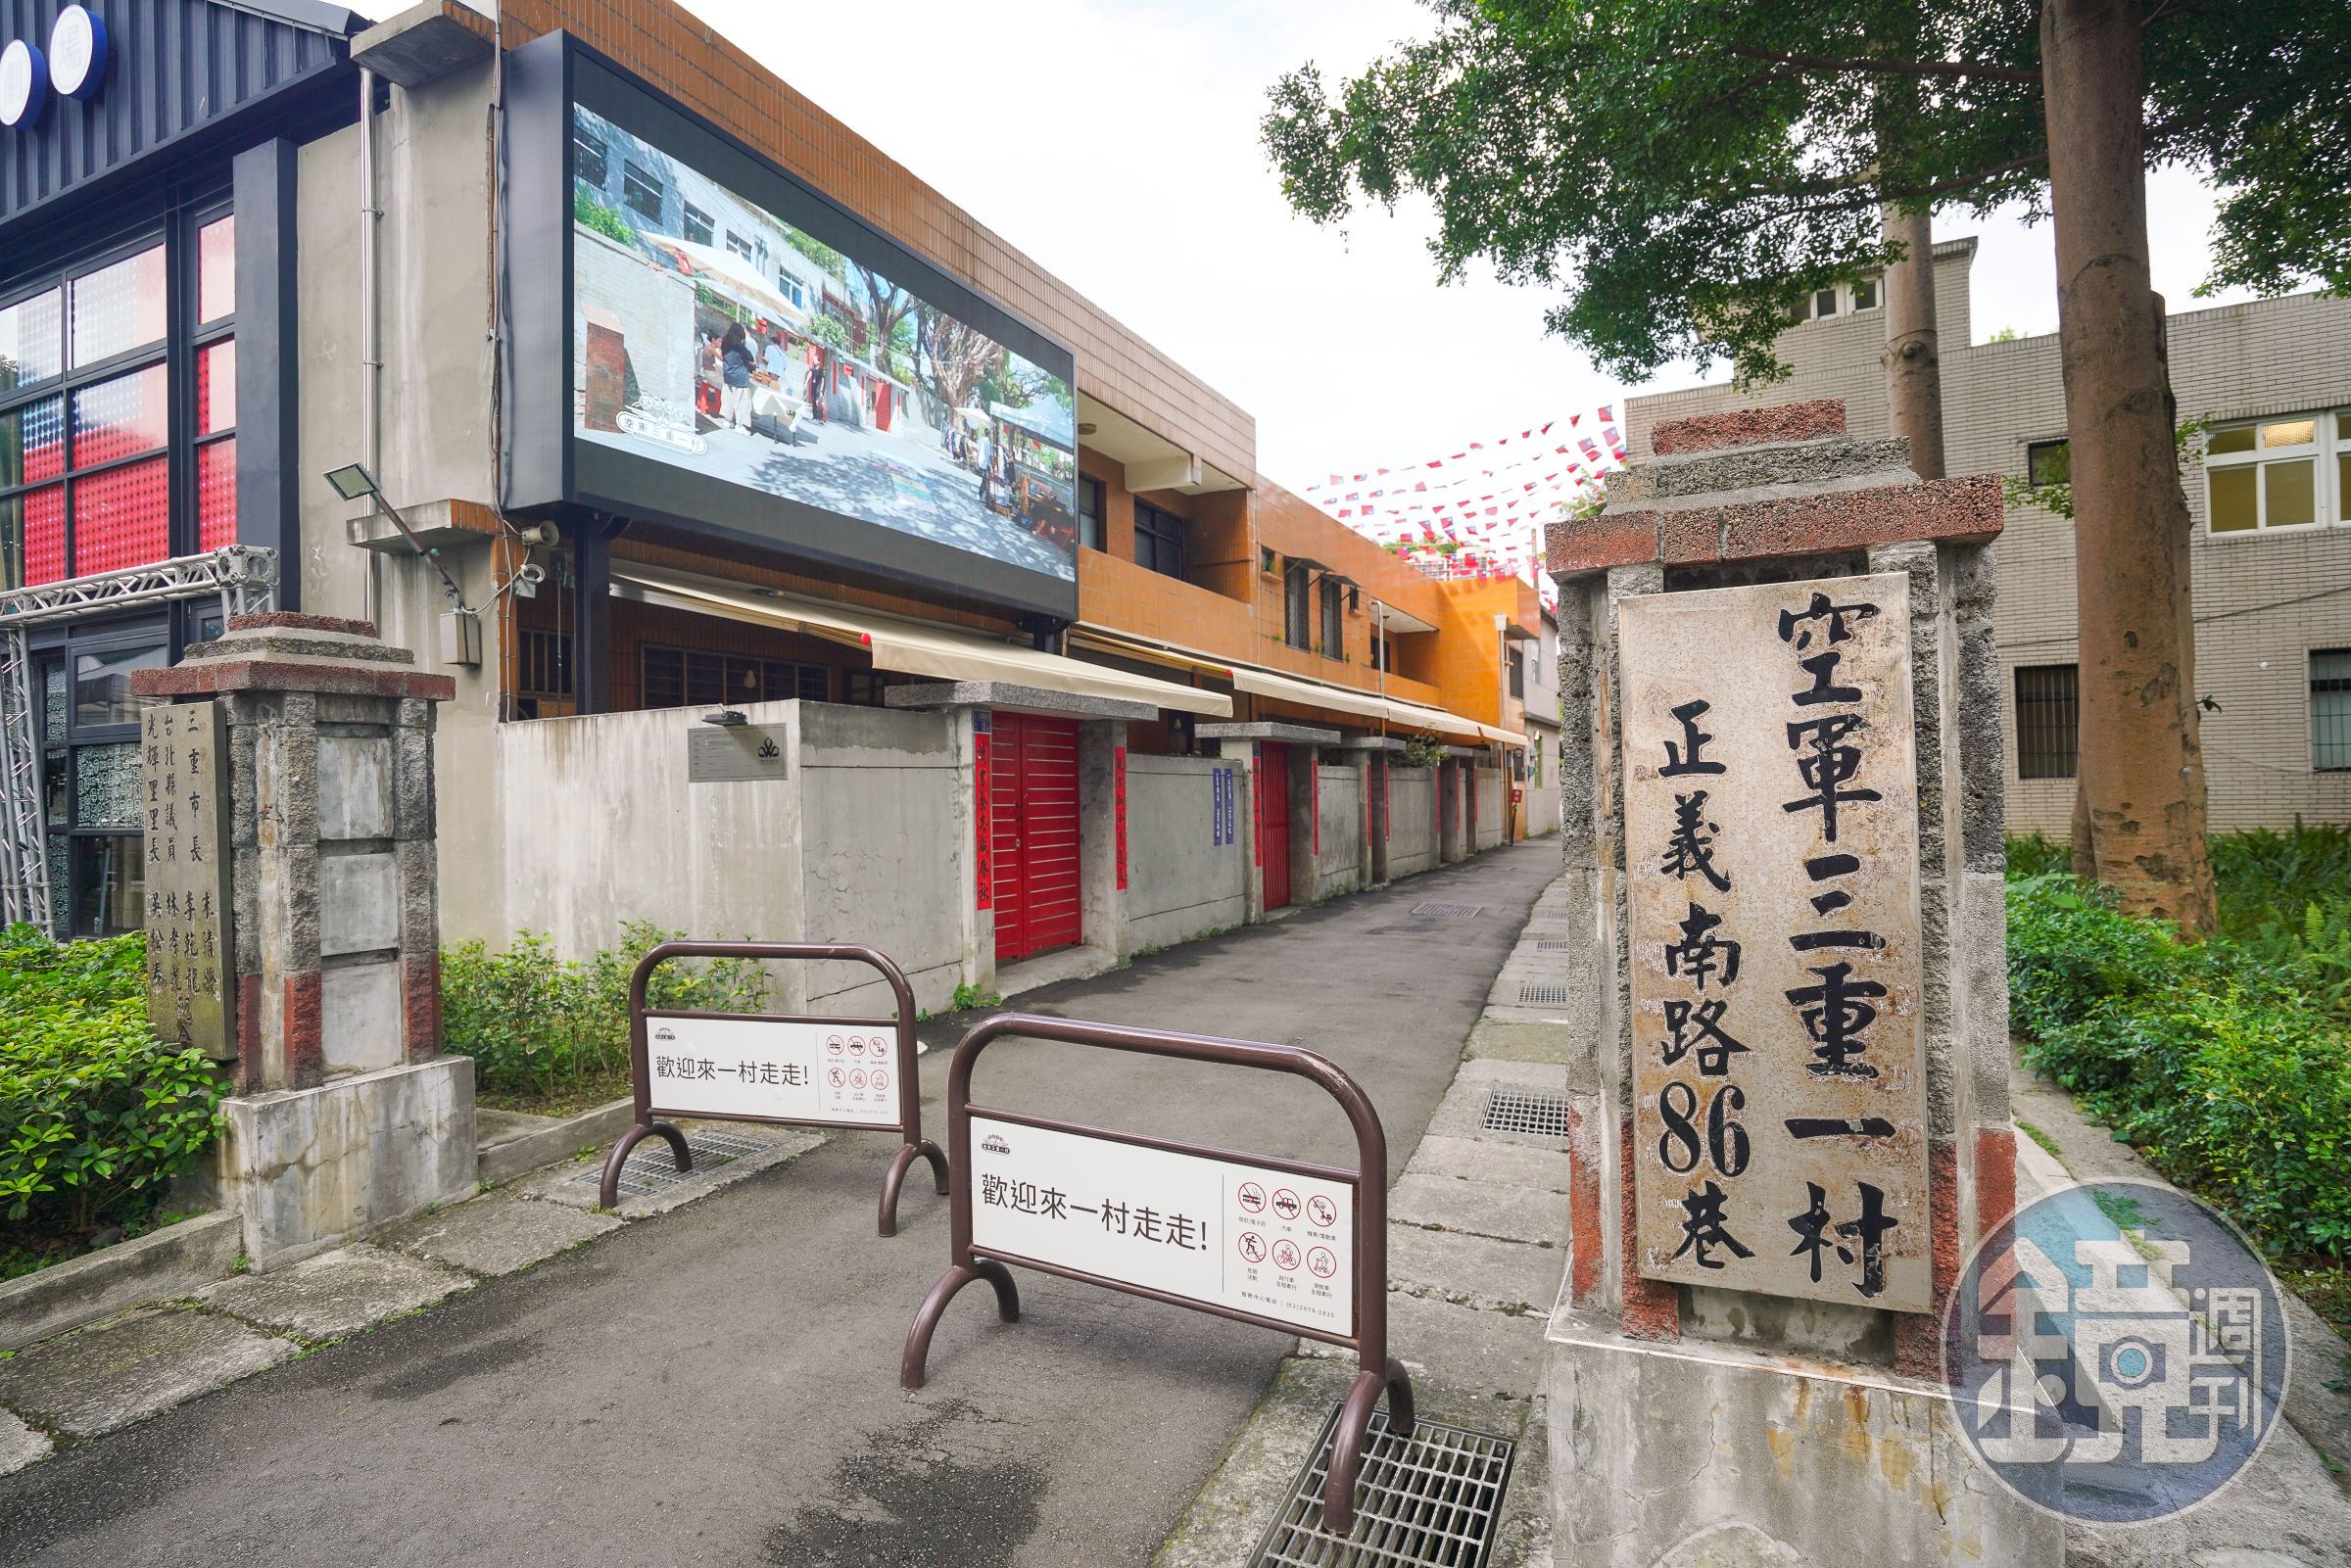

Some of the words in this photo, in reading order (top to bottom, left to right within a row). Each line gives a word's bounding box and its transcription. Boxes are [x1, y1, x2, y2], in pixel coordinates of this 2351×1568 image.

[655, 1055, 809, 1086] 歡迎來一村走走!
[1657, 699, 1755, 1269] 正義南路86巷
[1777, 591, 1899, 1298] 空軍三重一村
[982, 1173, 1208, 1251] 歡迎來一村走走!
